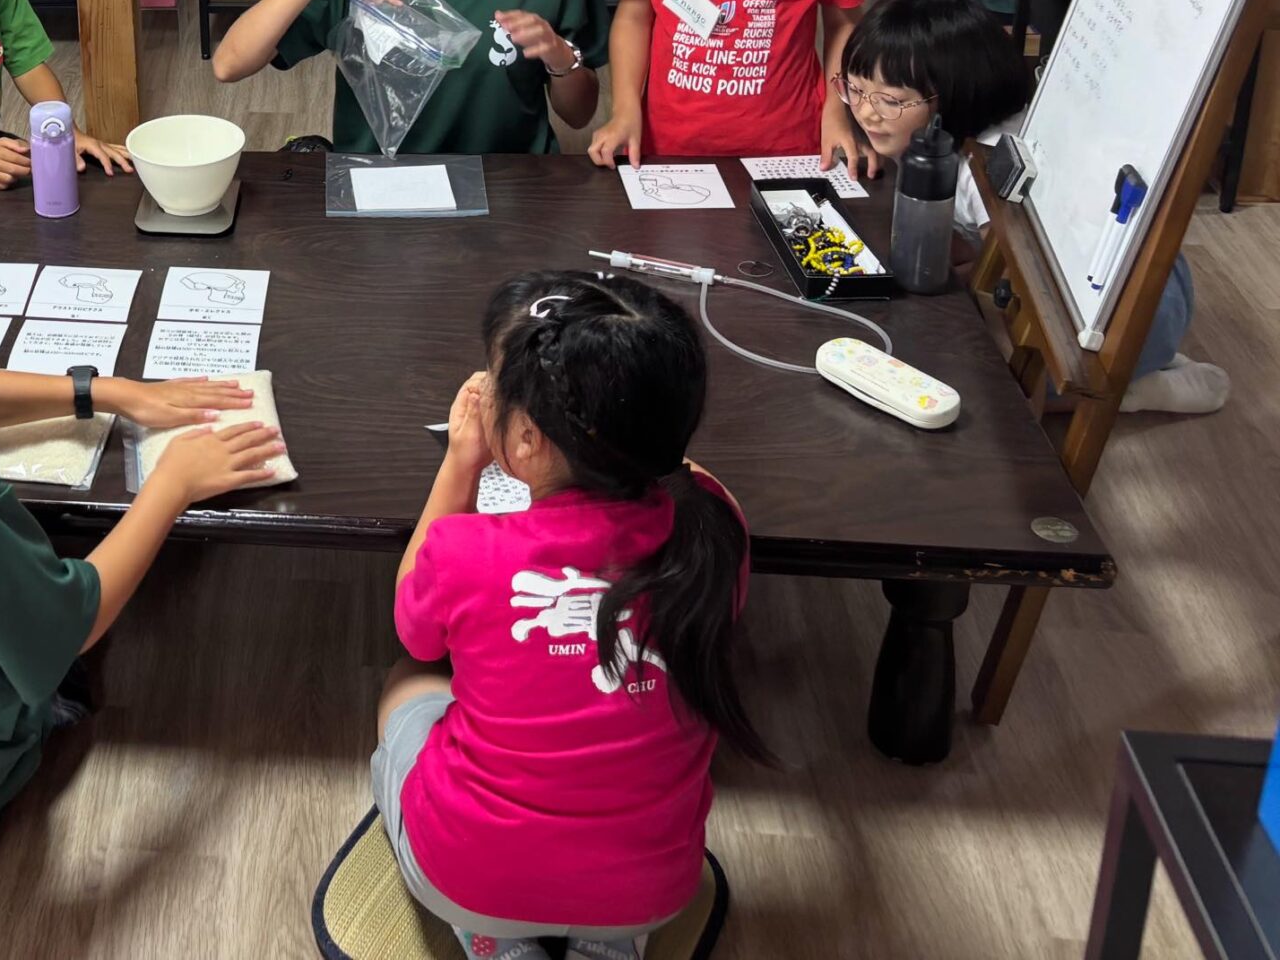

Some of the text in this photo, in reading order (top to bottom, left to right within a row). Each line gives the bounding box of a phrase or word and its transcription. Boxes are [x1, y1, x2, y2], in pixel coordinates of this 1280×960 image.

[742, 28, 774, 38] RUCKS
[733, 38, 772, 49] SCRUMS
[671, 42, 771, 65] TRY LINE-OUT
[691, 62, 718, 76] KICK
[732, 65, 767, 78] TOUCH
[667, 68, 766, 96] BONUS POINT
[548, 643, 587, 656] UMIN
